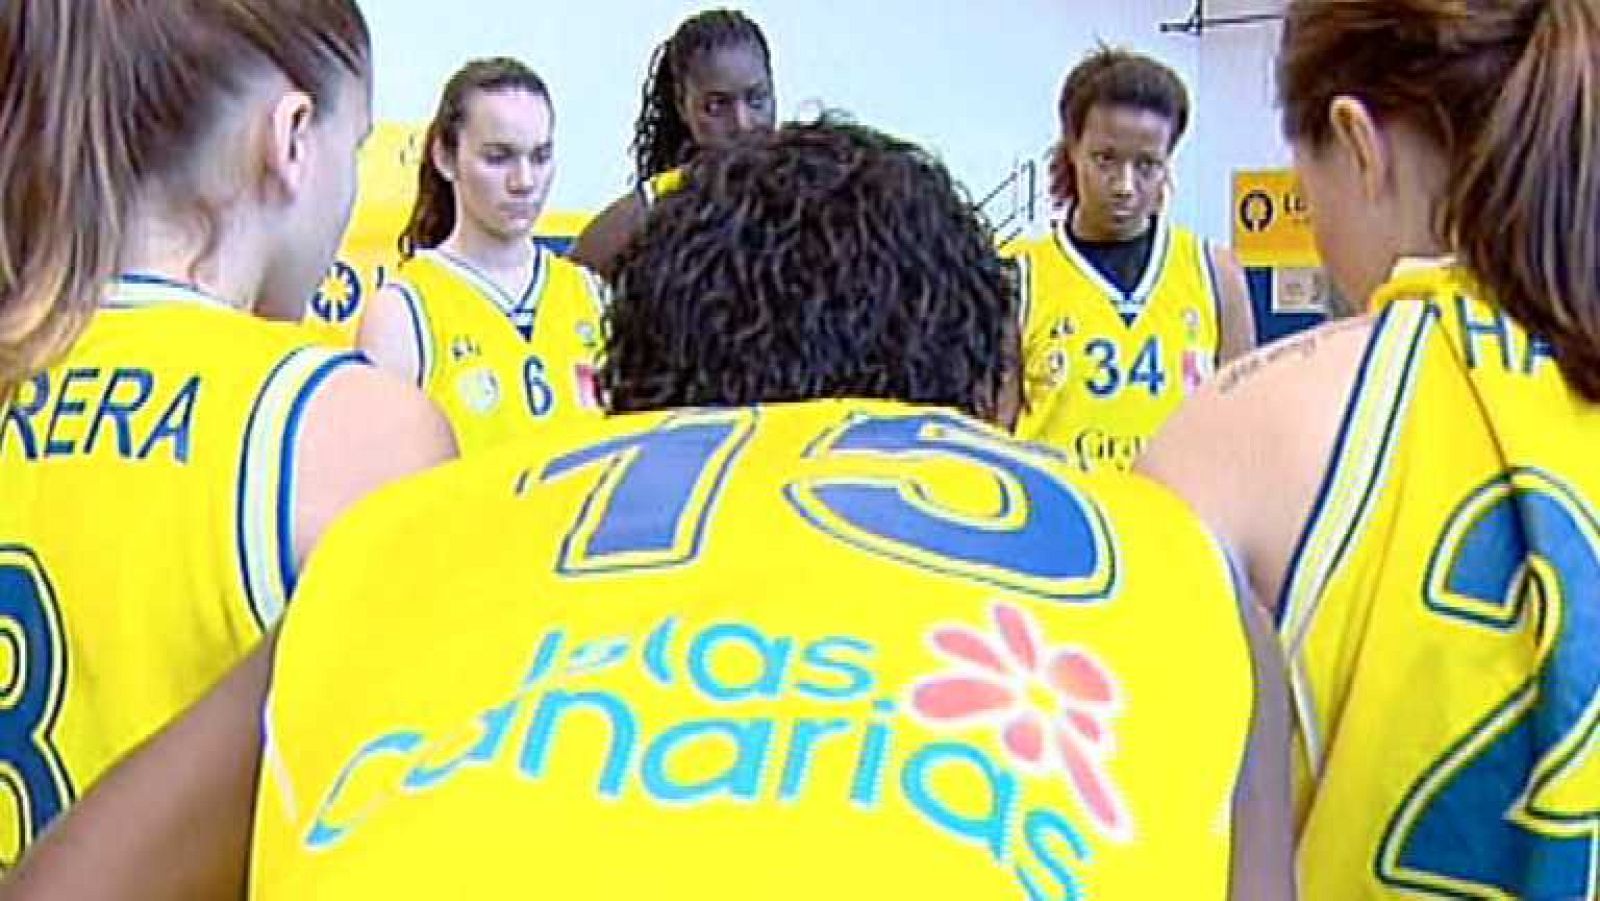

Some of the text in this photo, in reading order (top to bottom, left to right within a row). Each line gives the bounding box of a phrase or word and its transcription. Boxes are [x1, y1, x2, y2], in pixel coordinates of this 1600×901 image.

[523, 355, 554, 416] 6
[1084, 336, 1165, 397] 34
[0, 367, 200, 462] RERA
[516, 403, 1120, 601] 15
[1373, 467, 1600, 901] 2
